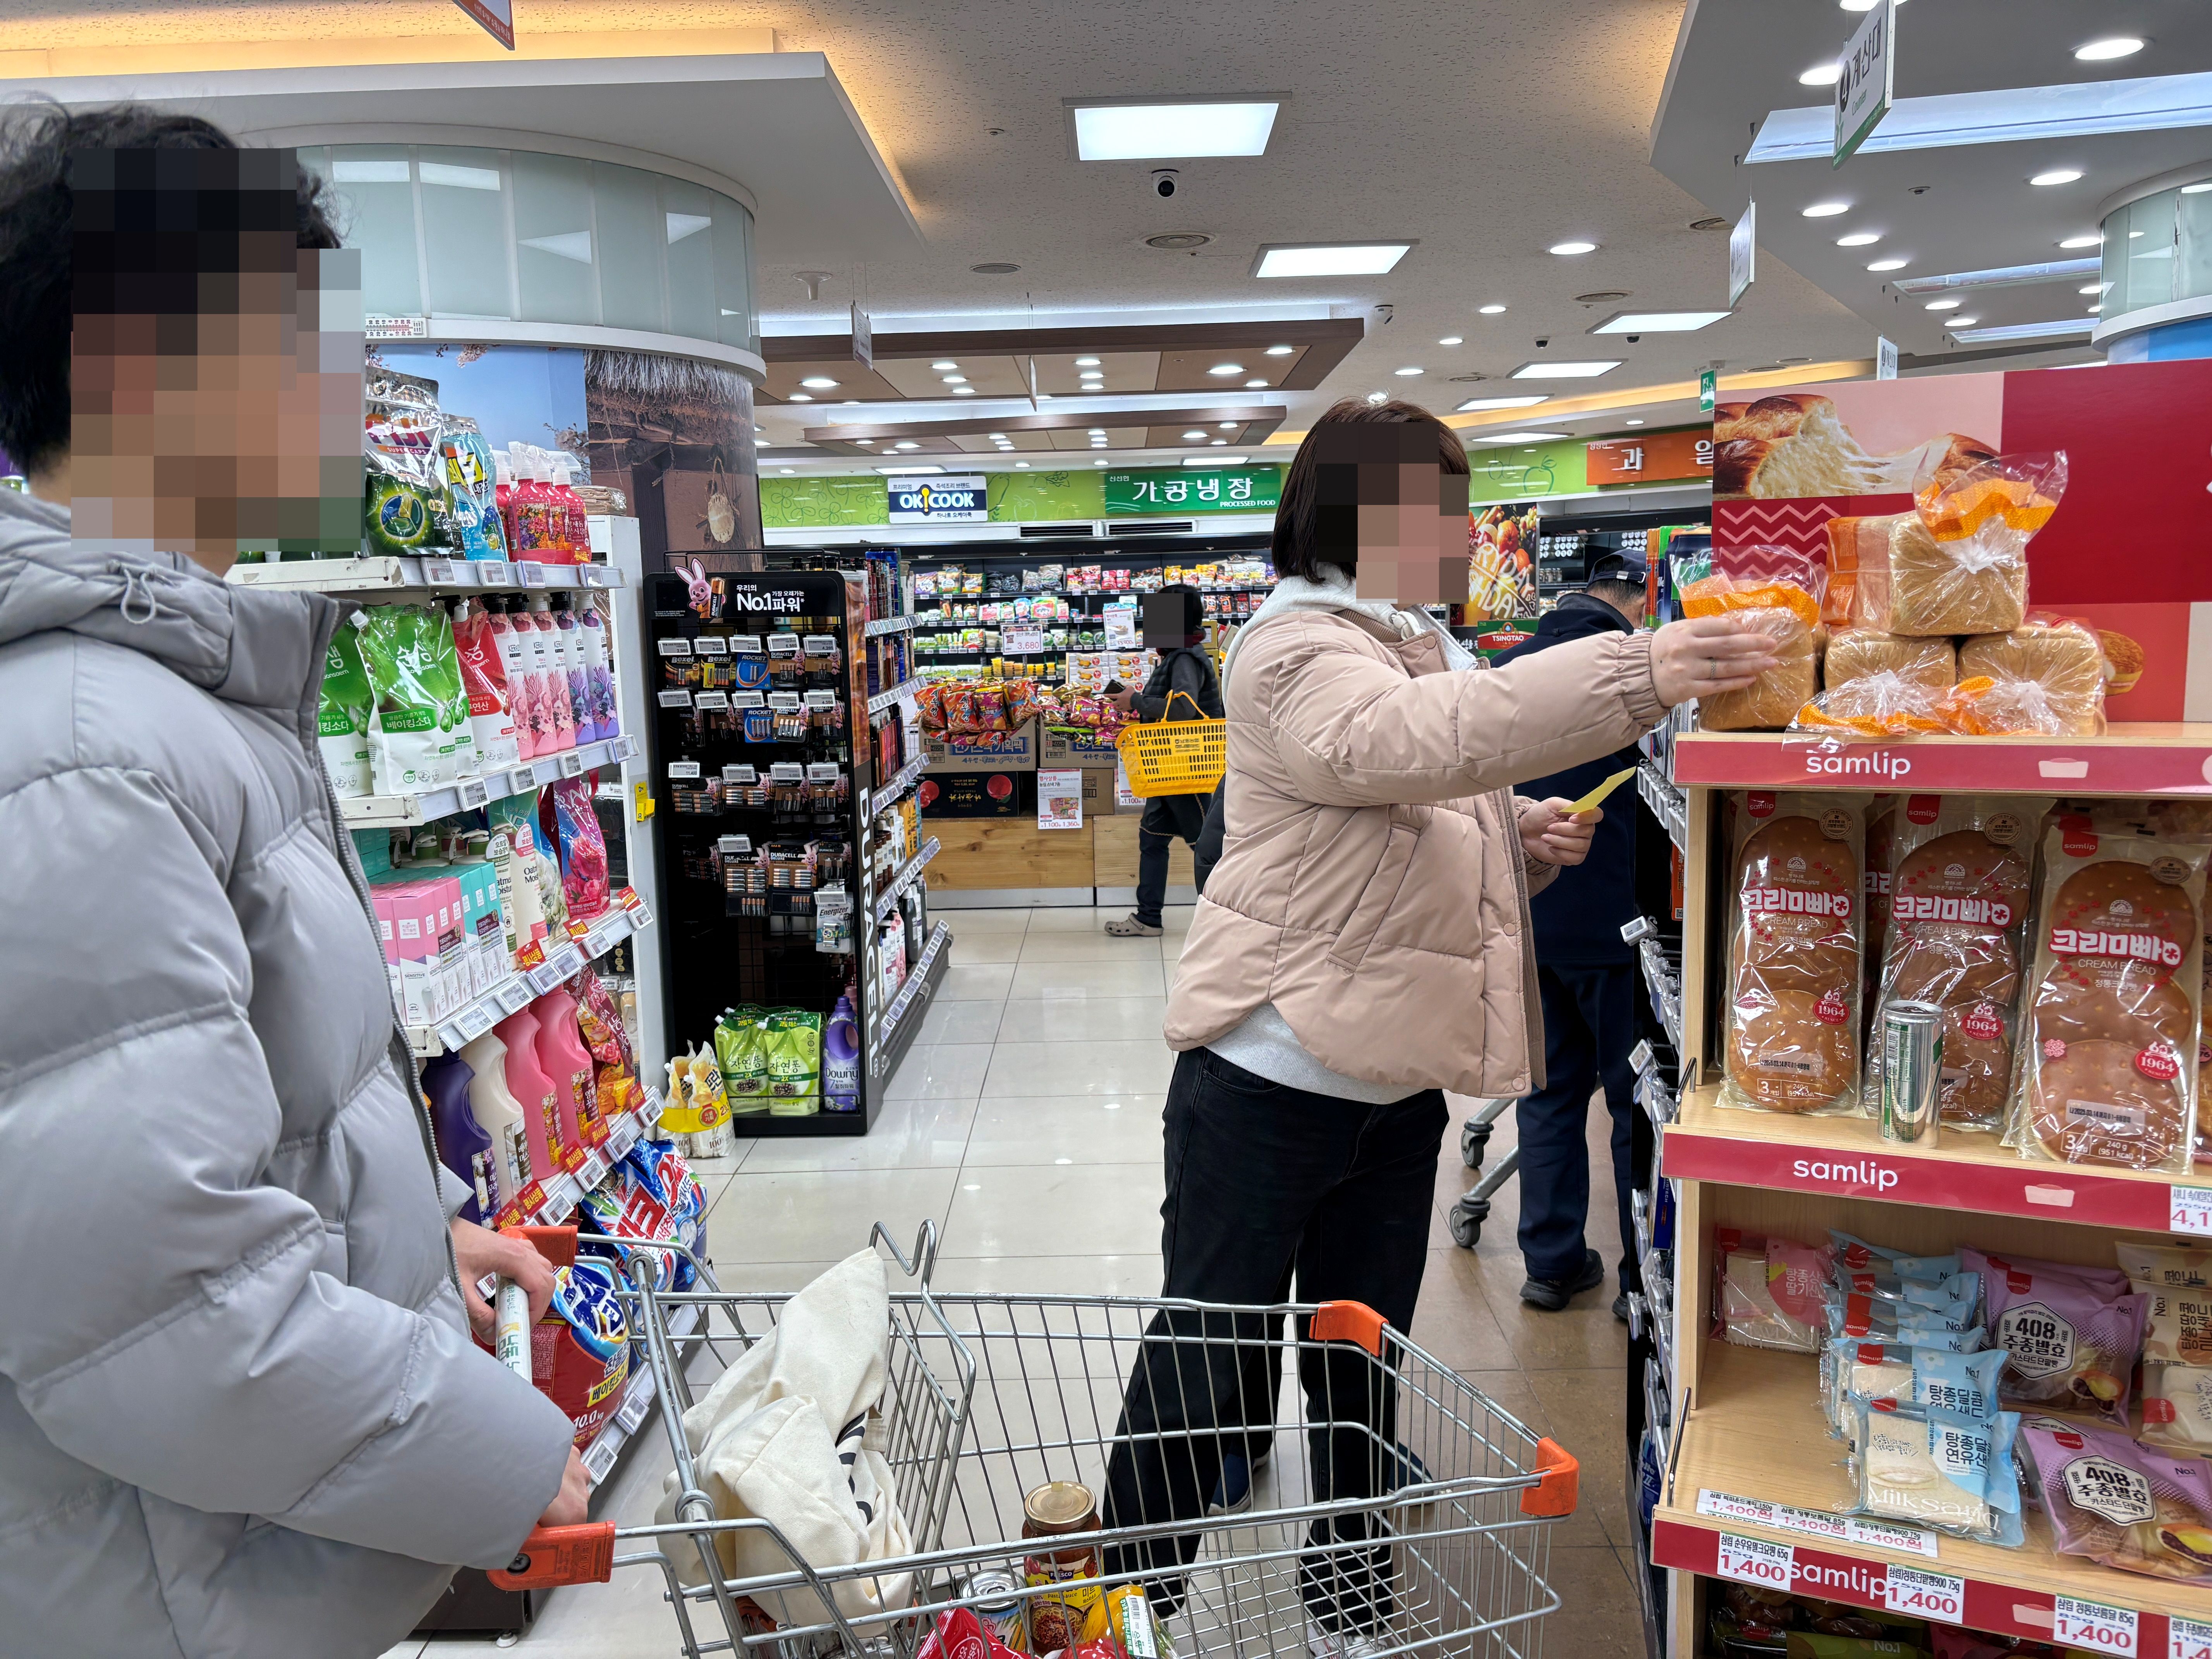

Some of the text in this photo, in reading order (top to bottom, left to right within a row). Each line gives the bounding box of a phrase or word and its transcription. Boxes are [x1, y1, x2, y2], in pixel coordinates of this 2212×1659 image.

[1841, 77, 1849, 103] 4
[1851, 16, 1881, 90] 계산대
[1620, 447, 1645, 471] 과
[1133, 478, 1253, 502] 가공냉장
[737, 593, 771, 611] No.1
[772, 597, 800, 612] 파워
[387, 716, 433, 729] 베이킹소다
[1806, 751, 1911, 780] samlip
[1749, 801, 1774, 811] samlip
[1908, 809, 1937, 818] samlip
[2064, 843, 2095, 851] samlip
[819, 907, 849, 917] Energizer
[1764, 917, 1828, 929] CREAM BREAD
[1914, 925, 1949, 934] CREAM
[859, 787, 878, 1076] DURACELL
[2078, 958, 2157, 975] CREAM BREAD
[1818, 1005, 1845, 1017] 1964
[1966, 1020, 1999, 1032] 1964
[731, 1056, 763, 1070] 자연퐁
[769, 1059, 801, 1074] 자연퐁
[2140, 1057, 2175, 1073] 1964
[826, 1068, 858, 1081] Downy
[1761, 1081, 1770, 1094] 3
[2064, 1134, 2076, 1150] 3
[2106, 1140, 2121, 1149] 240
[2098, 1147, 2115, 1157] (951
[1793, 1159, 1898, 1192] samlip
[2007, 1281, 2030, 1290] samlip
[2155, 1297, 2166, 1317] No.1
[2016, 1317, 2056, 1340] 408
[2003, 1334, 2066, 1358] 주종발효
[2037, 1357, 2058, 1368] 단팥빵
[1965, 1366, 1980, 1379] No.1
[2057, 1437, 2082, 1446] samlip
[2086, 1467, 2131, 1488] 408
[2174, 1467, 2196, 1475] No.1
[1869, 1486, 1917, 1509] Milk
[2077, 1482, 2150, 1506] 주종발효
[1712, 1501, 1772, 1520] 1,400원
[1759, 1502, 1772, 1511] 150g
[2091, 1498, 2123, 1509] 카스타드
[1784, 1516, 1846, 1535] 1,400원
[1833, 1516, 1846, 1525] 85g
[1858, 1531, 1922, 1550] 1,400원
[1910, 1530, 1921, 1540] 75g
[1721, 1535, 1733, 1547] 삼립
[1777, 1546, 1788, 1561] 65g
[1722, 1549, 1753, 1559] 65g
[1721, 1554, 1786, 1582] 1,400
[1791, 1562, 1886, 1600] samlip
[1948, 1580, 1960, 1593] 75g
[1887, 1587, 1957, 1614] 1,400
[2057, 1598, 2074, 1611] 삼립
[2118, 1607, 2134, 1626] 85g
[2057, 1620, 2131, 1648] 1,400
[1873, 1640, 1901, 1654] No.1
